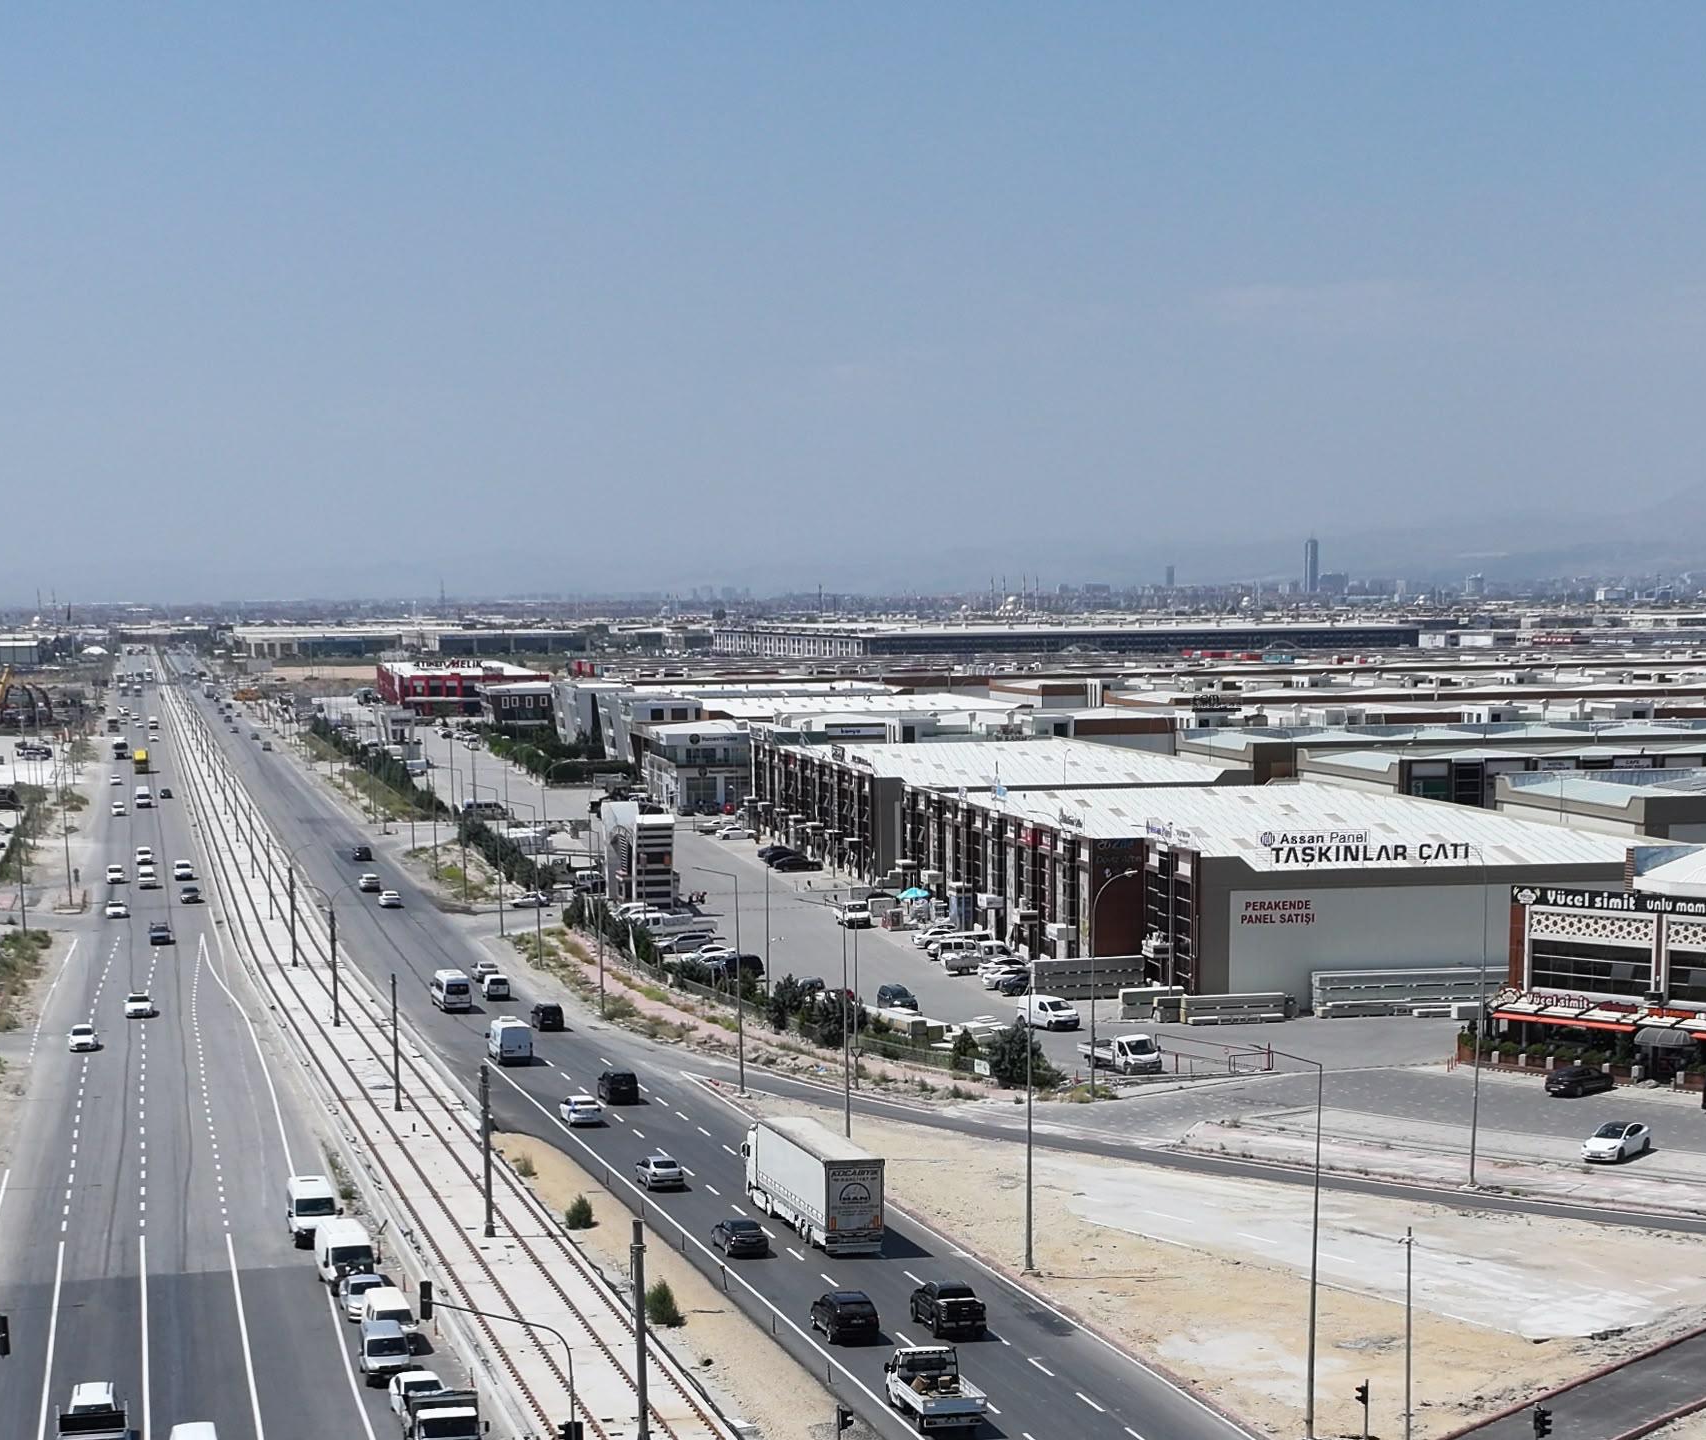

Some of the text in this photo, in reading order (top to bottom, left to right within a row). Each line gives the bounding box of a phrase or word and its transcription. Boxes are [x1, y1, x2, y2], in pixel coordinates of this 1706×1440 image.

[1280, 831, 1368, 844] Assan Panel
[1271, 842, 1470, 867] TAŞKINLAR ÇATI
[1245, 900, 1311, 911] PERAKENDE
[1547, 890, 1590, 907] Yücel
[1594, 892, 1636, 911] simit
[1646, 898, 1673, 911] unlu
[1241, 913, 1315, 925] PANEL SATIŞI
[1526, 994, 1557, 1007] Yücel
[1558, 994, 1590, 1009] simit
